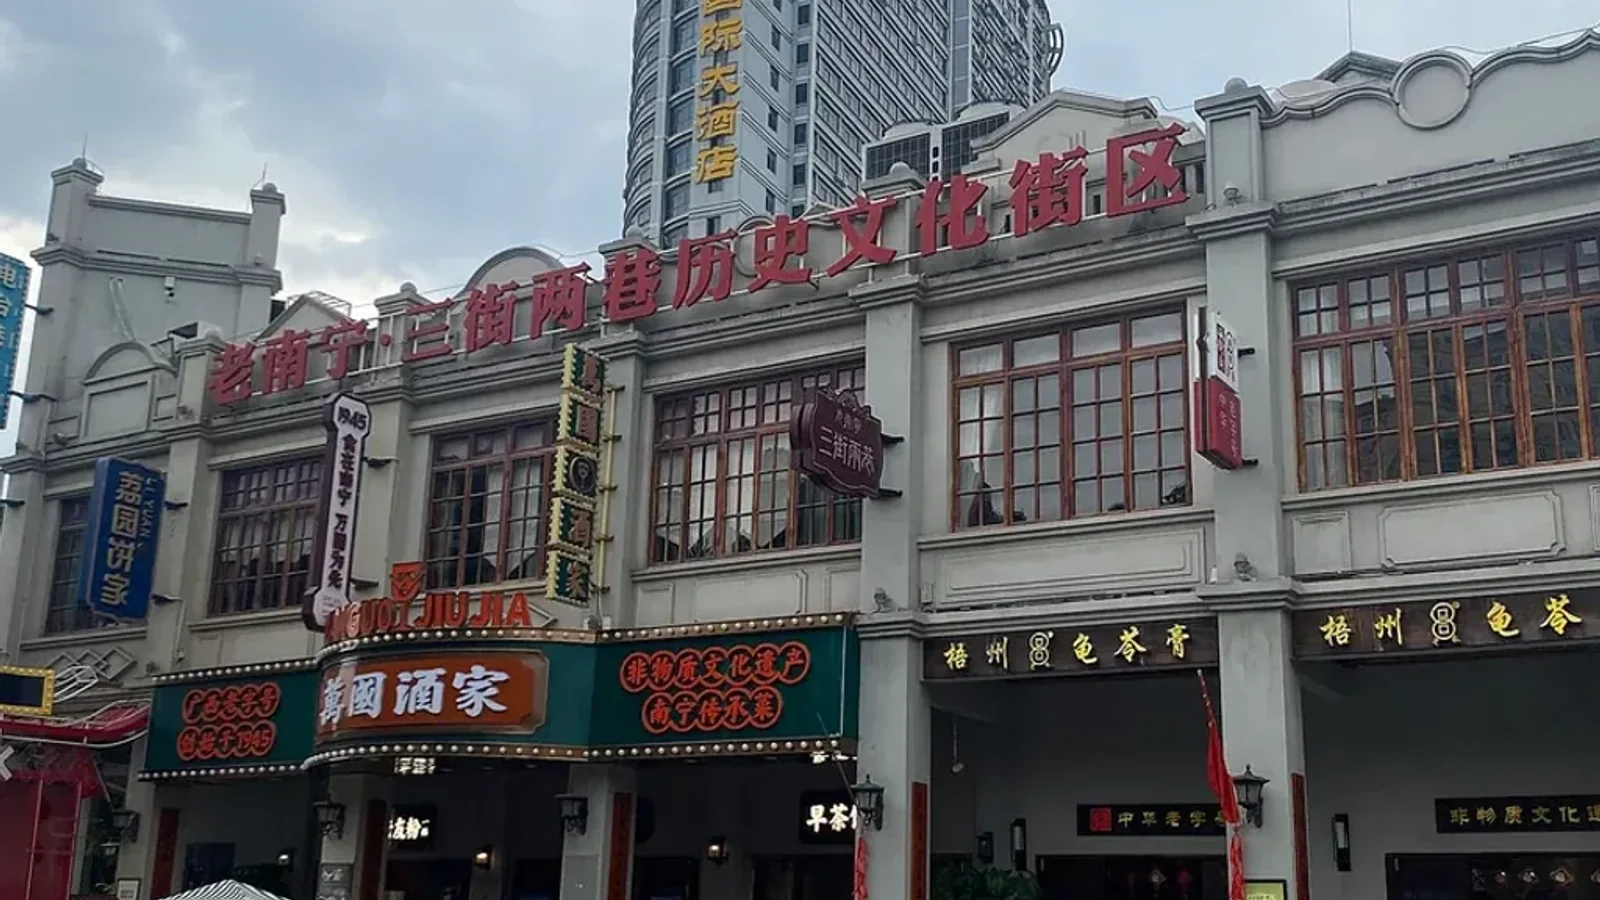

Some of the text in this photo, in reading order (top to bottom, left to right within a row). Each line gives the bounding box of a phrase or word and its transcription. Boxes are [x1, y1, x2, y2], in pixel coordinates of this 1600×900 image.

[208, 121, 1190, 404] 老南宁·三街两巷历史文化街区
[338, 406, 367, 430] 1945
[624, 643, 808, 682] 非物质文化遗产
[319, 663, 511, 732] 萬國酒家
[648, 690, 778, 727] 南宁传承菜
